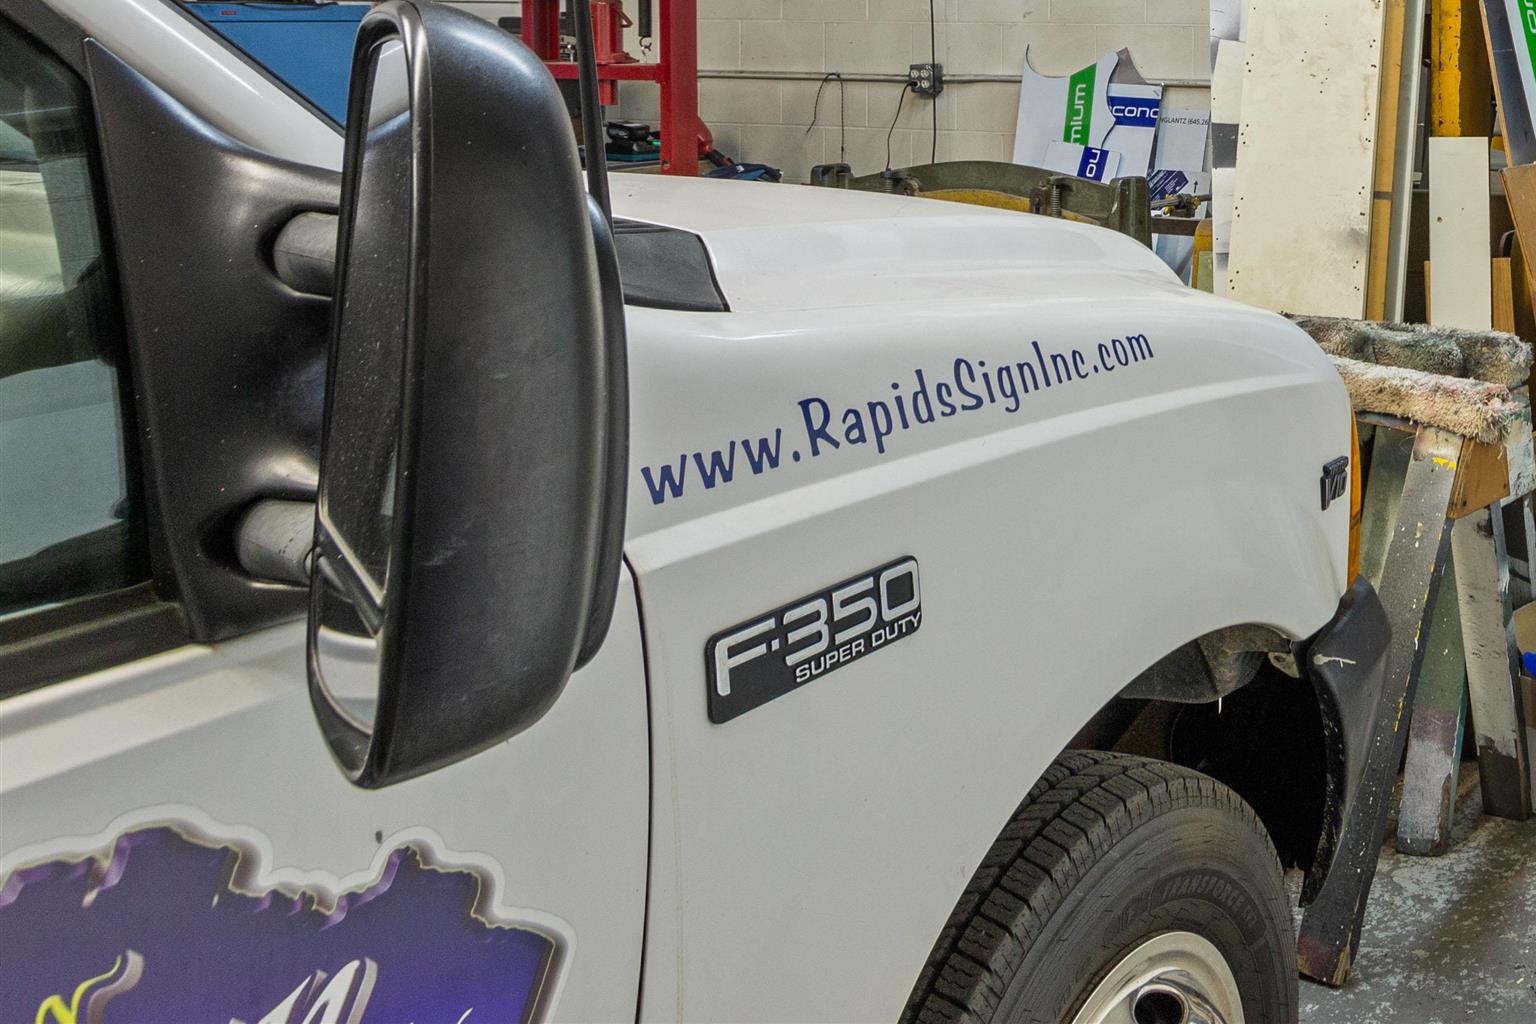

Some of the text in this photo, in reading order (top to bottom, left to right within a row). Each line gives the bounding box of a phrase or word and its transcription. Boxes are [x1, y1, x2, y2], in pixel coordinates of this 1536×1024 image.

[640, 332, 1154, 505] www.RapidsSignInc.com
[795, 611, 921, 683] SUPER DUTY
